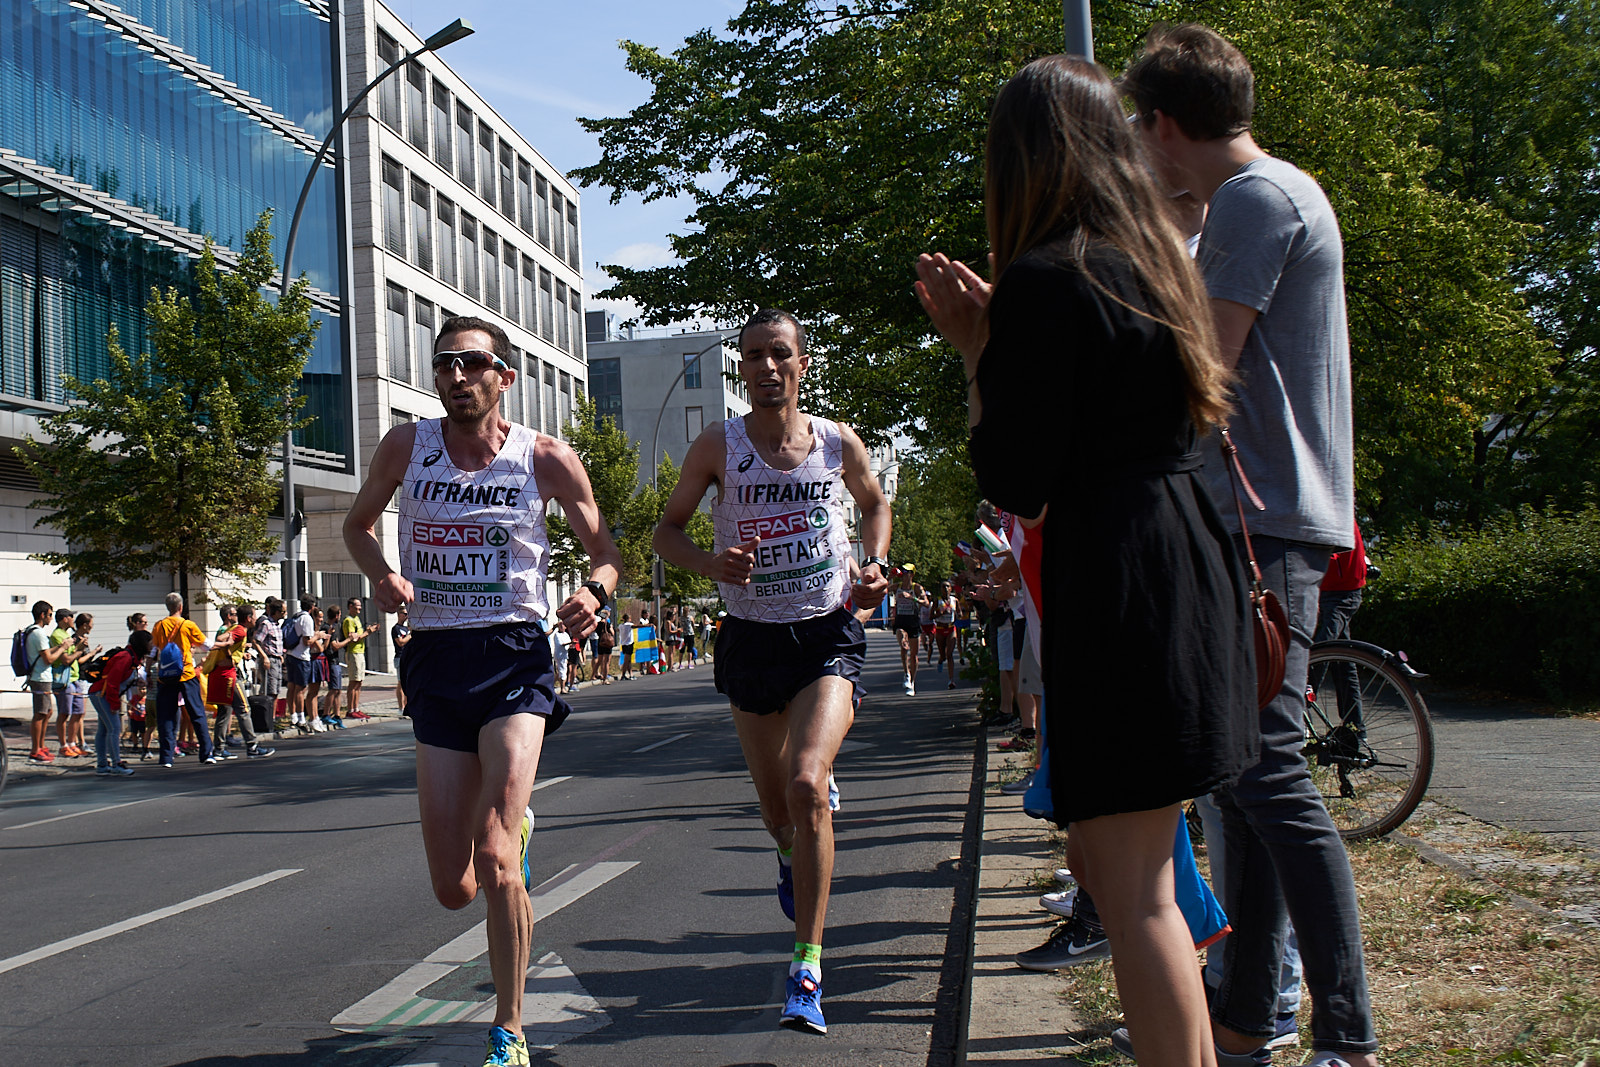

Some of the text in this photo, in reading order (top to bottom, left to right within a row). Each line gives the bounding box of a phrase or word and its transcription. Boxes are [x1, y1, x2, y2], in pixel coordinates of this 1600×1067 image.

[431, 482, 520, 507] FRANCE
[753, 480, 832, 503] FRANCE
[414, 525, 481, 543] SPAR
[740, 514, 807, 539] SPAR
[416, 550, 493, 576] MALATY
[770, 571, 789, 581] RUN
[431, 581, 435, 589] I
[436, 582, 454, 591] RUN
[756, 580, 802, 597] BERLIN
[421, 591, 502, 607] BERLIN 2018
